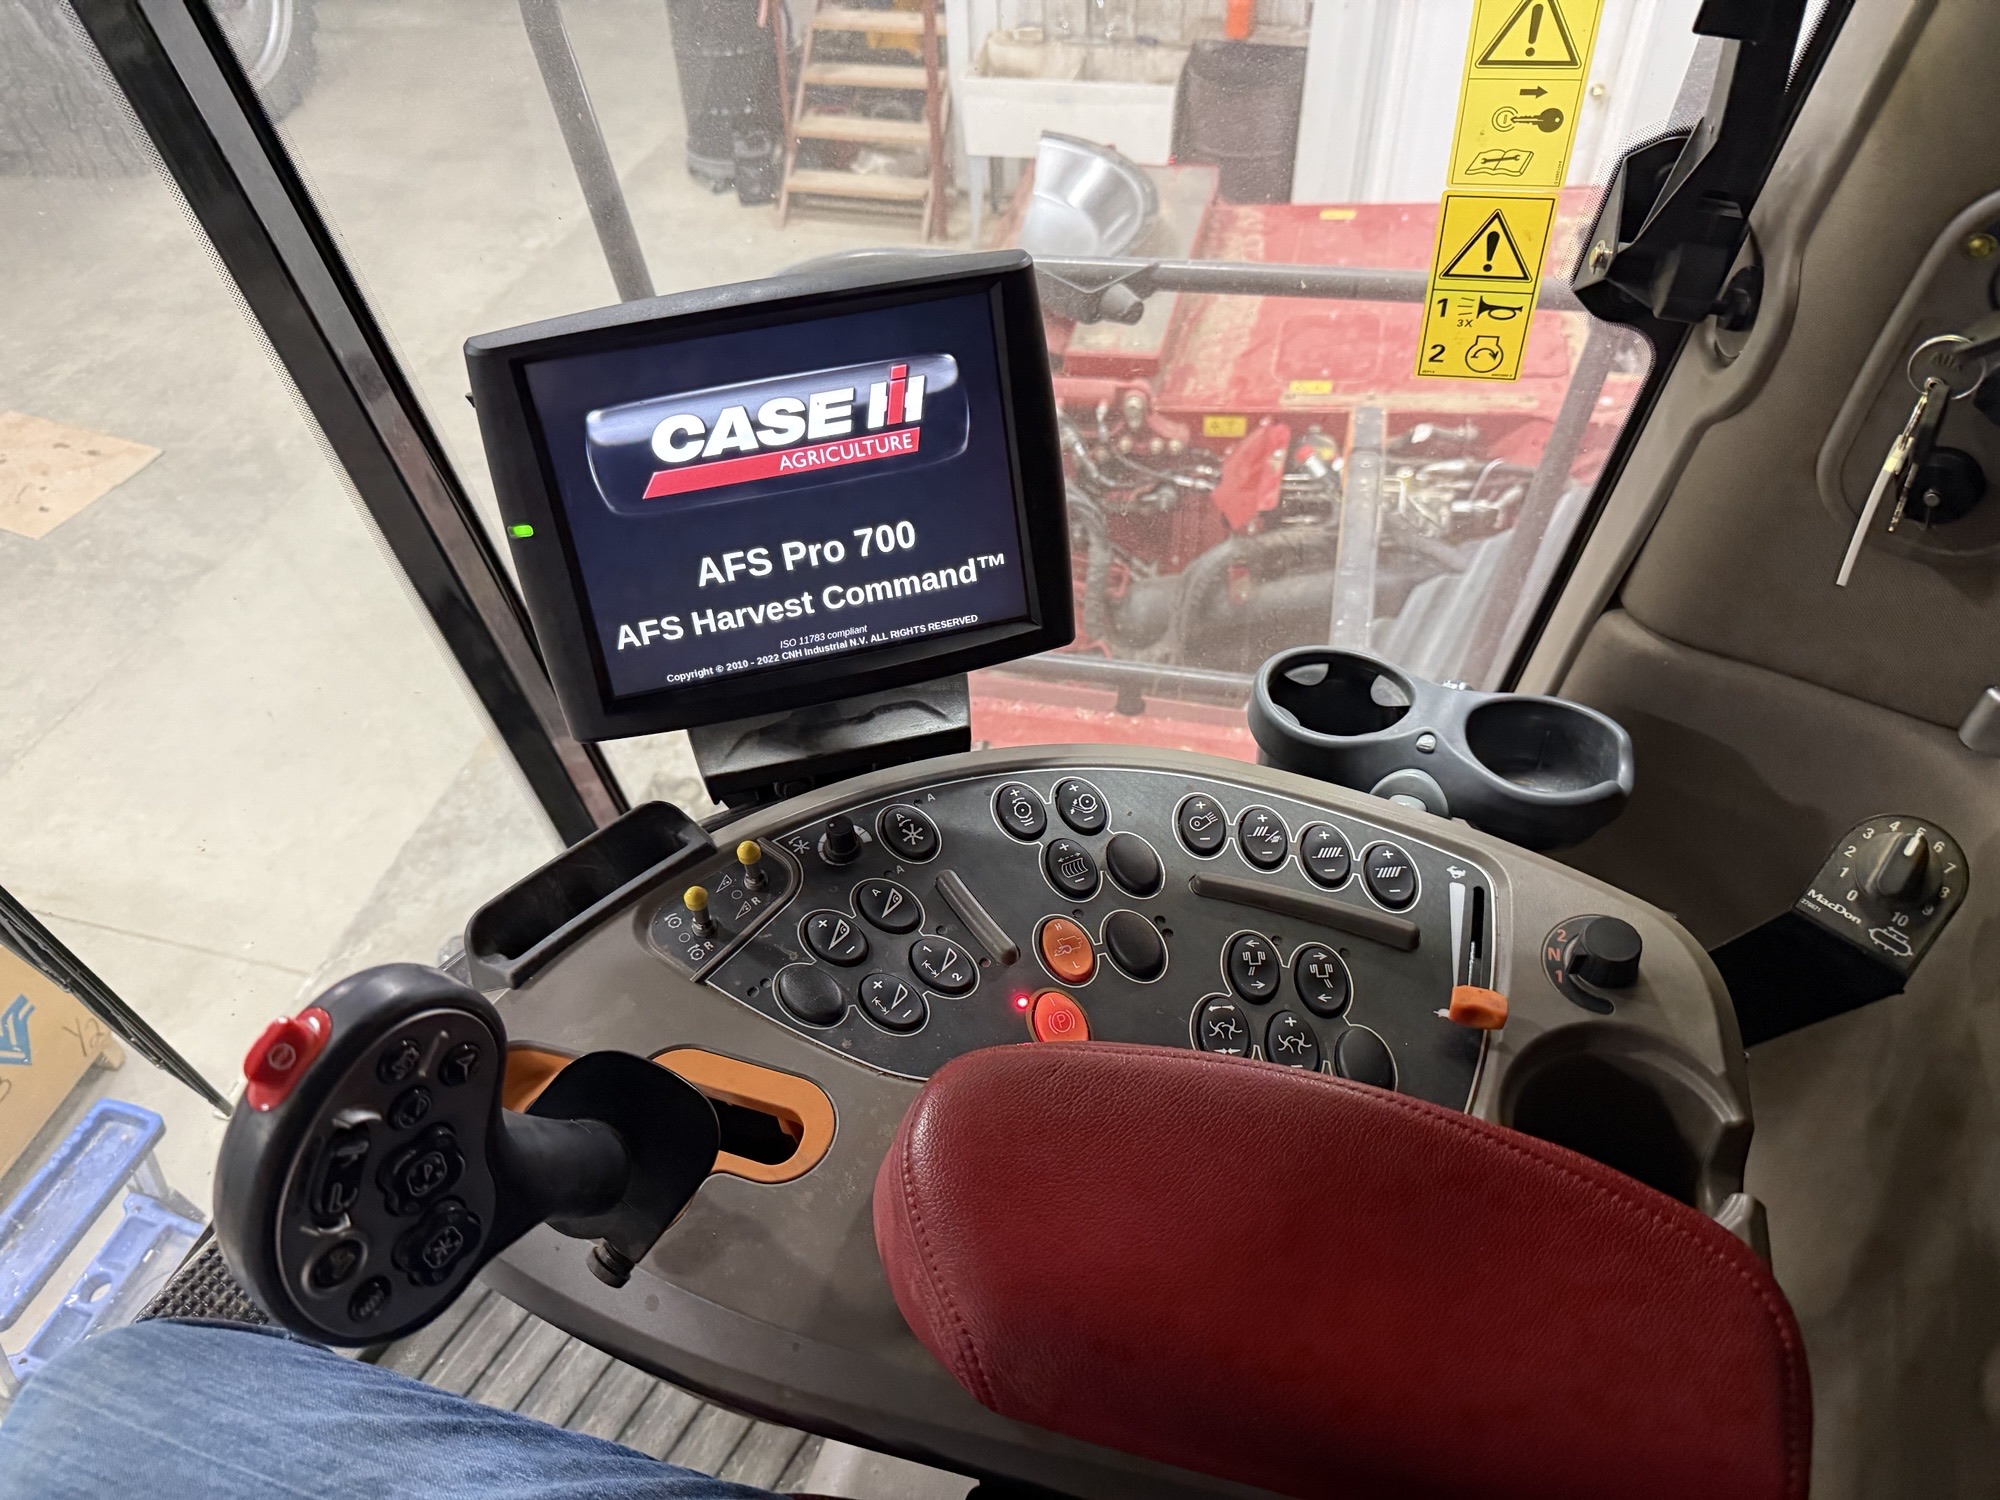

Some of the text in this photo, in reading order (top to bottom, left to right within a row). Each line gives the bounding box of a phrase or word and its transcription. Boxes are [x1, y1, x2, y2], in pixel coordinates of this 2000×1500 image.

[1437, 298, 1448, 317] 1
[1457, 319, 1473, 327] 3X
[1428, 344, 1446, 363] 2
[651, 387, 855, 463] CASE
[779, 432, 914, 471] AGRICULTURE
[698, 520, 916, 587] AFS Pro 700
[616, 615, 684, 651] AFS
[690, 591, 814, 636] Harvest
[780, 625, 868, 649] ISO 11783 compliant
[666, 667, 714, 682] Copyright
[726, 660, 748, 671] 2010
[757, 654, 780, 666] 2022
[782, 650, 803, 660] CNH
[804, 639, 848, 656] Industrial
[850, 637, 868, 647] N.V.
[871, 632, 888, 643] ALL
[890, 625, 926, 639] RIGHTS
[928, 614, 978, 631] RESERVED
[927, 793, 936, 802] A
[1889, 821, 1901, 832] 4
[1862, 828, 1875, 839] 3
[1843, 845, 1857, 858] 2
[1933, 841, 1945, 853] 6
[896, 865, 905, 874] A
[1839, 867, 1849, 878] 1
[1943, 862, 1957, 874] 7
[872, 888, 881, 897] A
[1846, 889, 1858, 901] 0
[751, 896, 761, 905] R
[1807, 889, 1861, 924] MacDon
[1891, 912, 1909, 926] 10
[1054, 922, 1062, 931] H
[1557, 929, 1567, 942] 2
[703, 941, 714, 951] R
[1547, 947, 1561, 961] N
[951, 972, 963, 982] 2
[1555, 969, 1563, 984] 1
[1056, 1014, 1065, 1028] P
